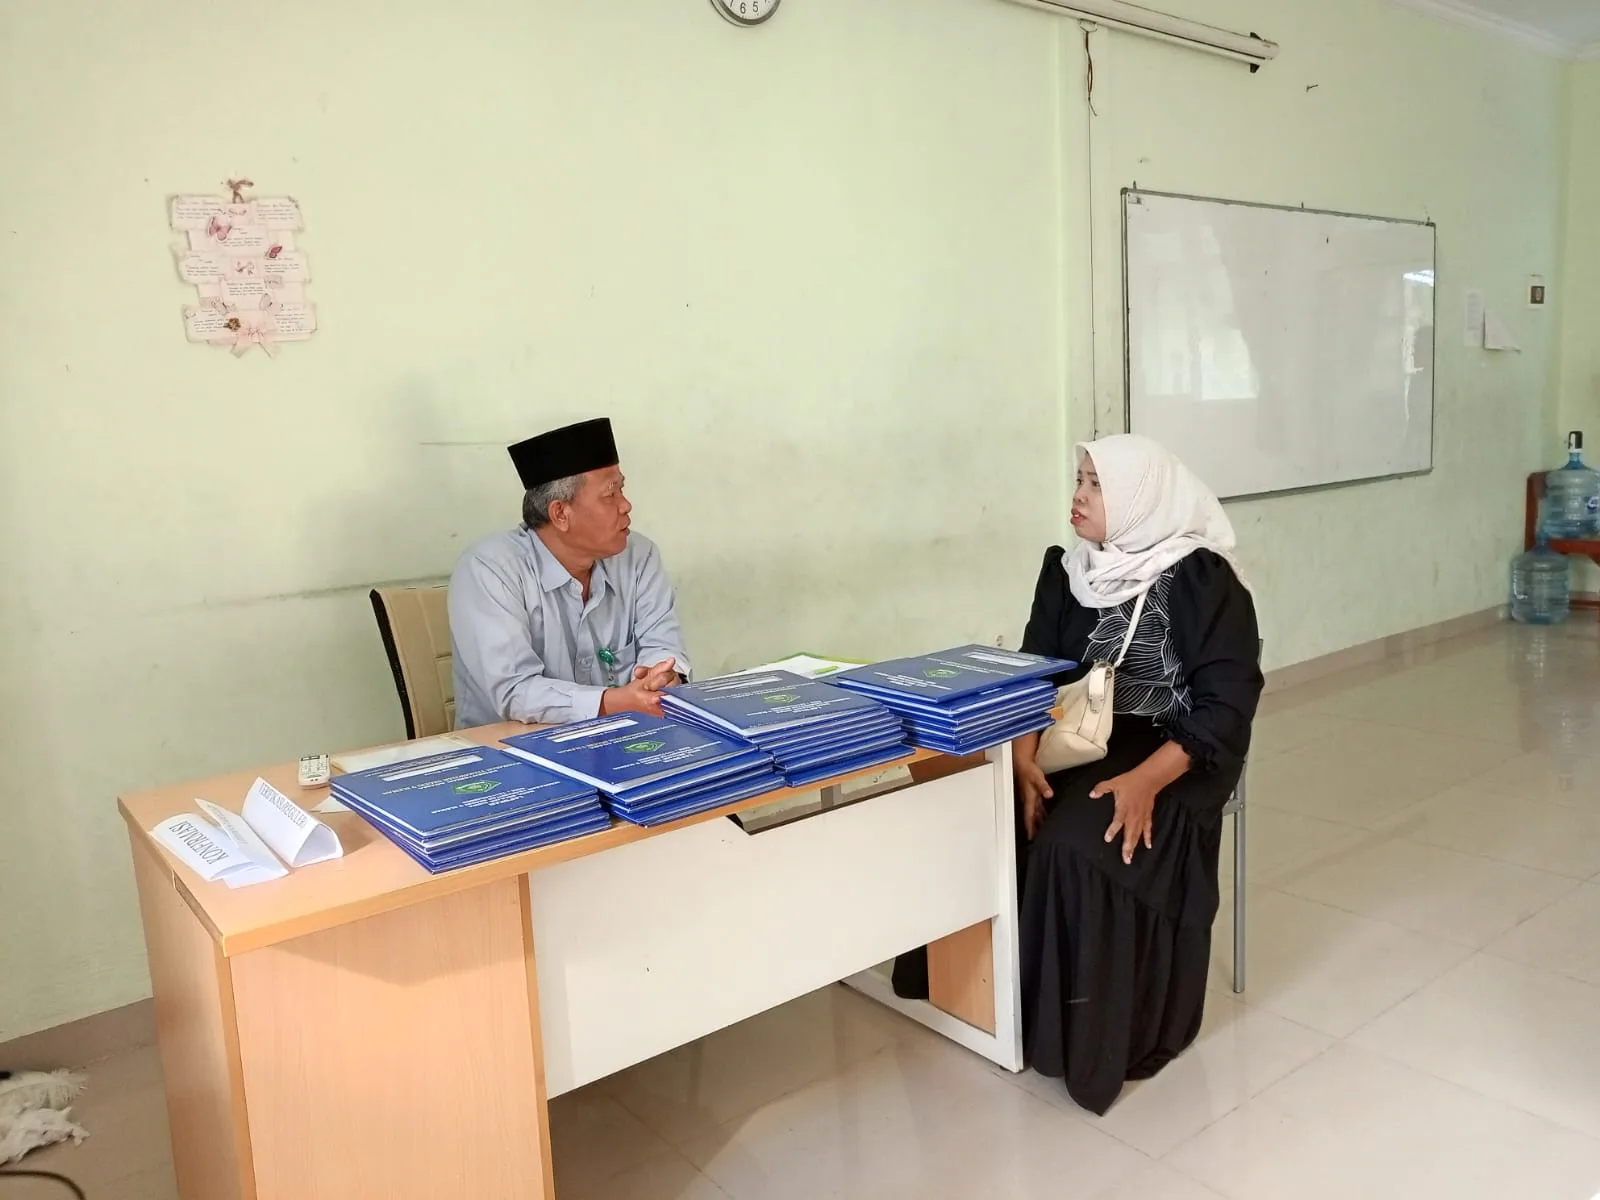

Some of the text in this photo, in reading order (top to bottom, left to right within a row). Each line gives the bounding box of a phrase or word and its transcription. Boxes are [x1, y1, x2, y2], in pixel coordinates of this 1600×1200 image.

[740, 2, 746, 14] 6
[752, 1, 759, 13] 5
[168, 821, 230, 865] KONFIRMASI
